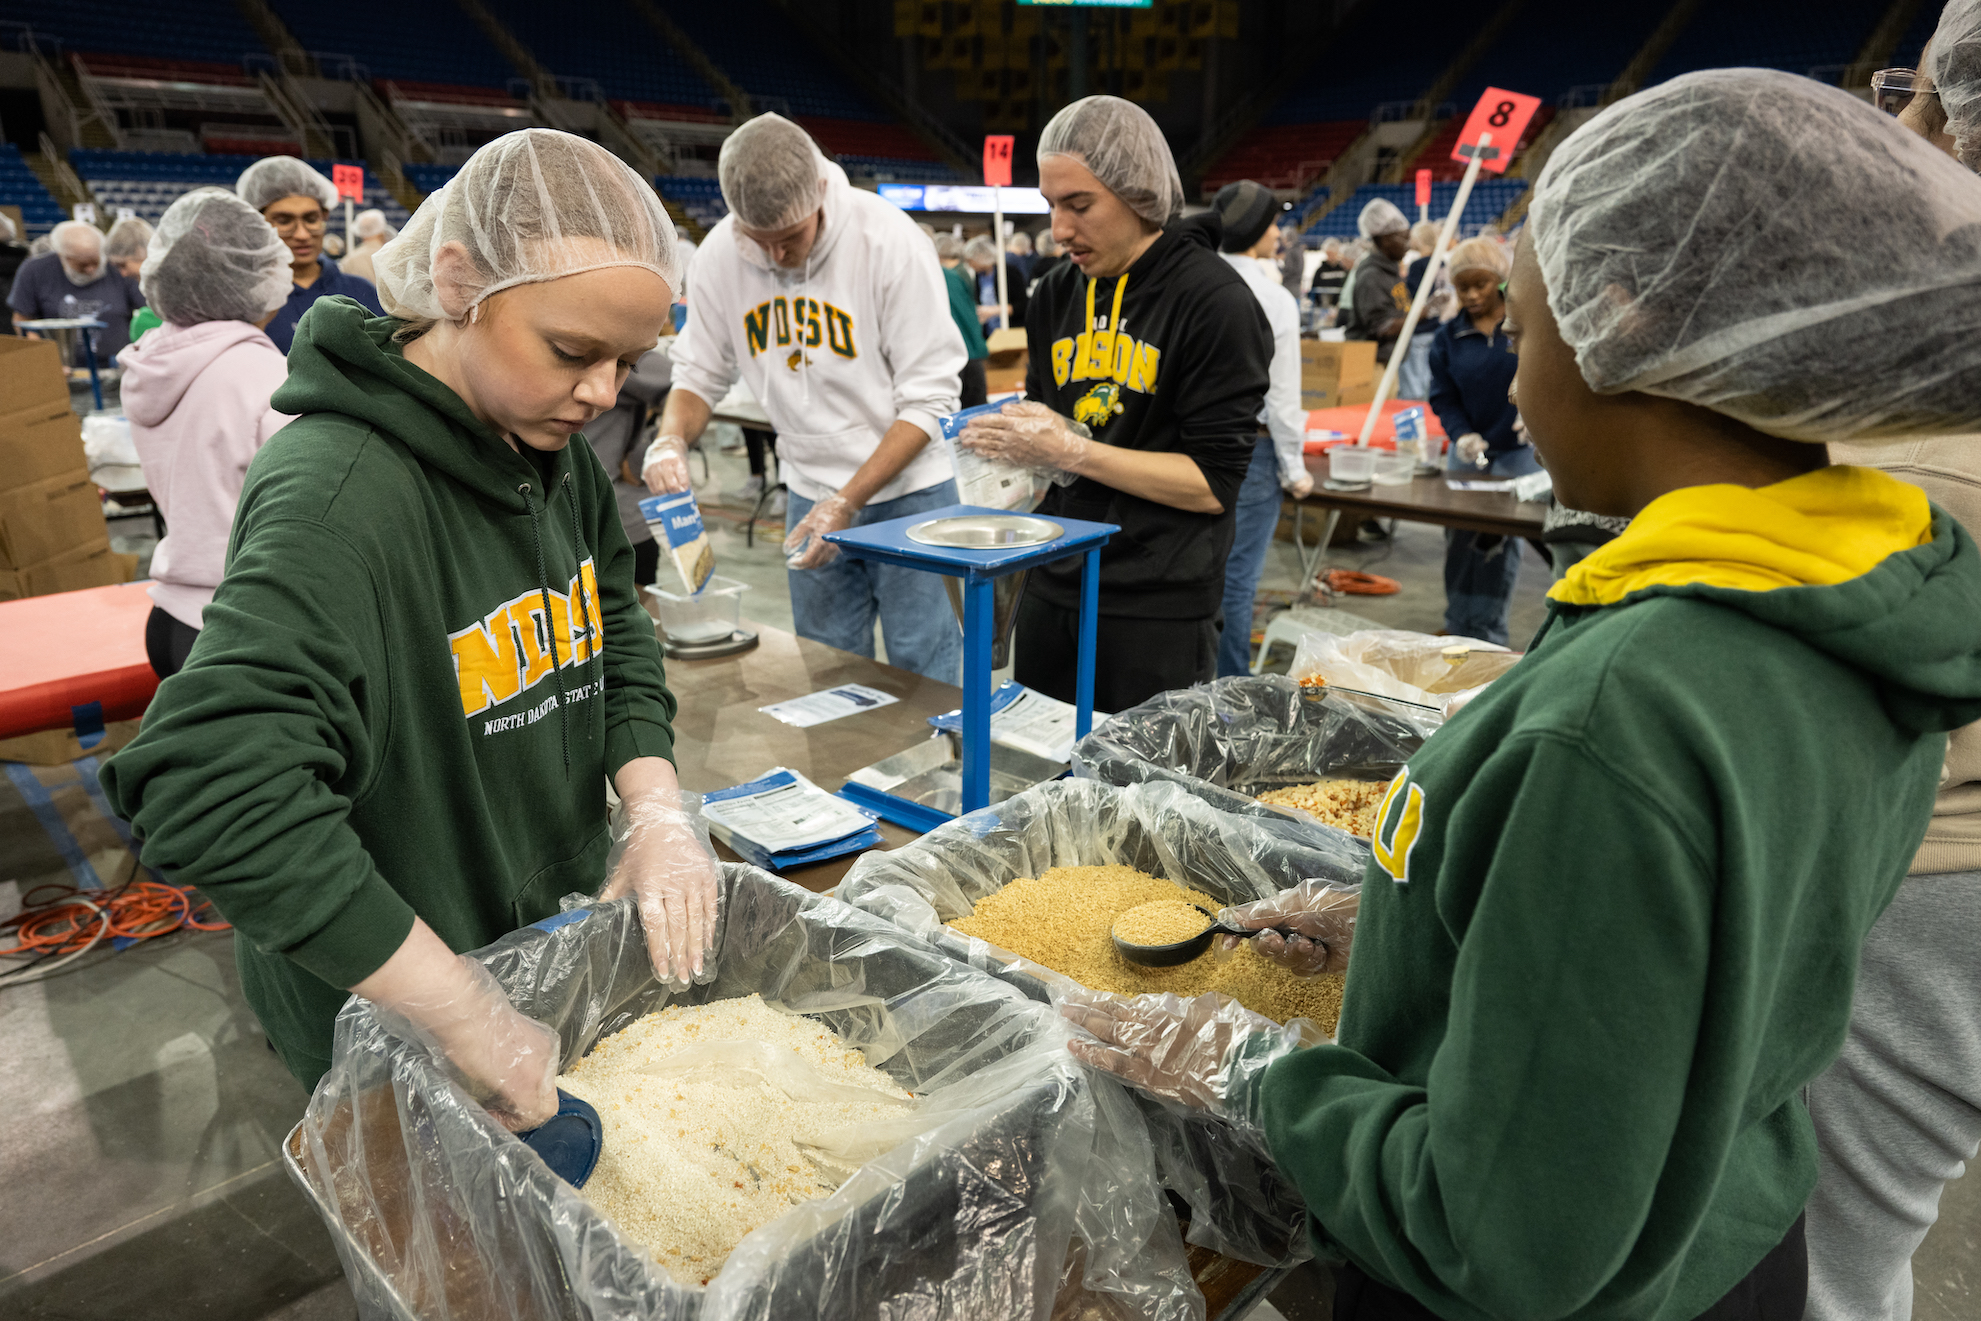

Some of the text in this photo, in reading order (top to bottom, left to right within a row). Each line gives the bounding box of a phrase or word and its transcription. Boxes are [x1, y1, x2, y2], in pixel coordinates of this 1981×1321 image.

[1488, 101, 1516, 127] 8
[990, 142, 1008, 160] 14
[744, 296, 857, 359] NDSU
[484, 711, 526, 736] NORTH
[527, 695, 559, 725] DAKOTA
